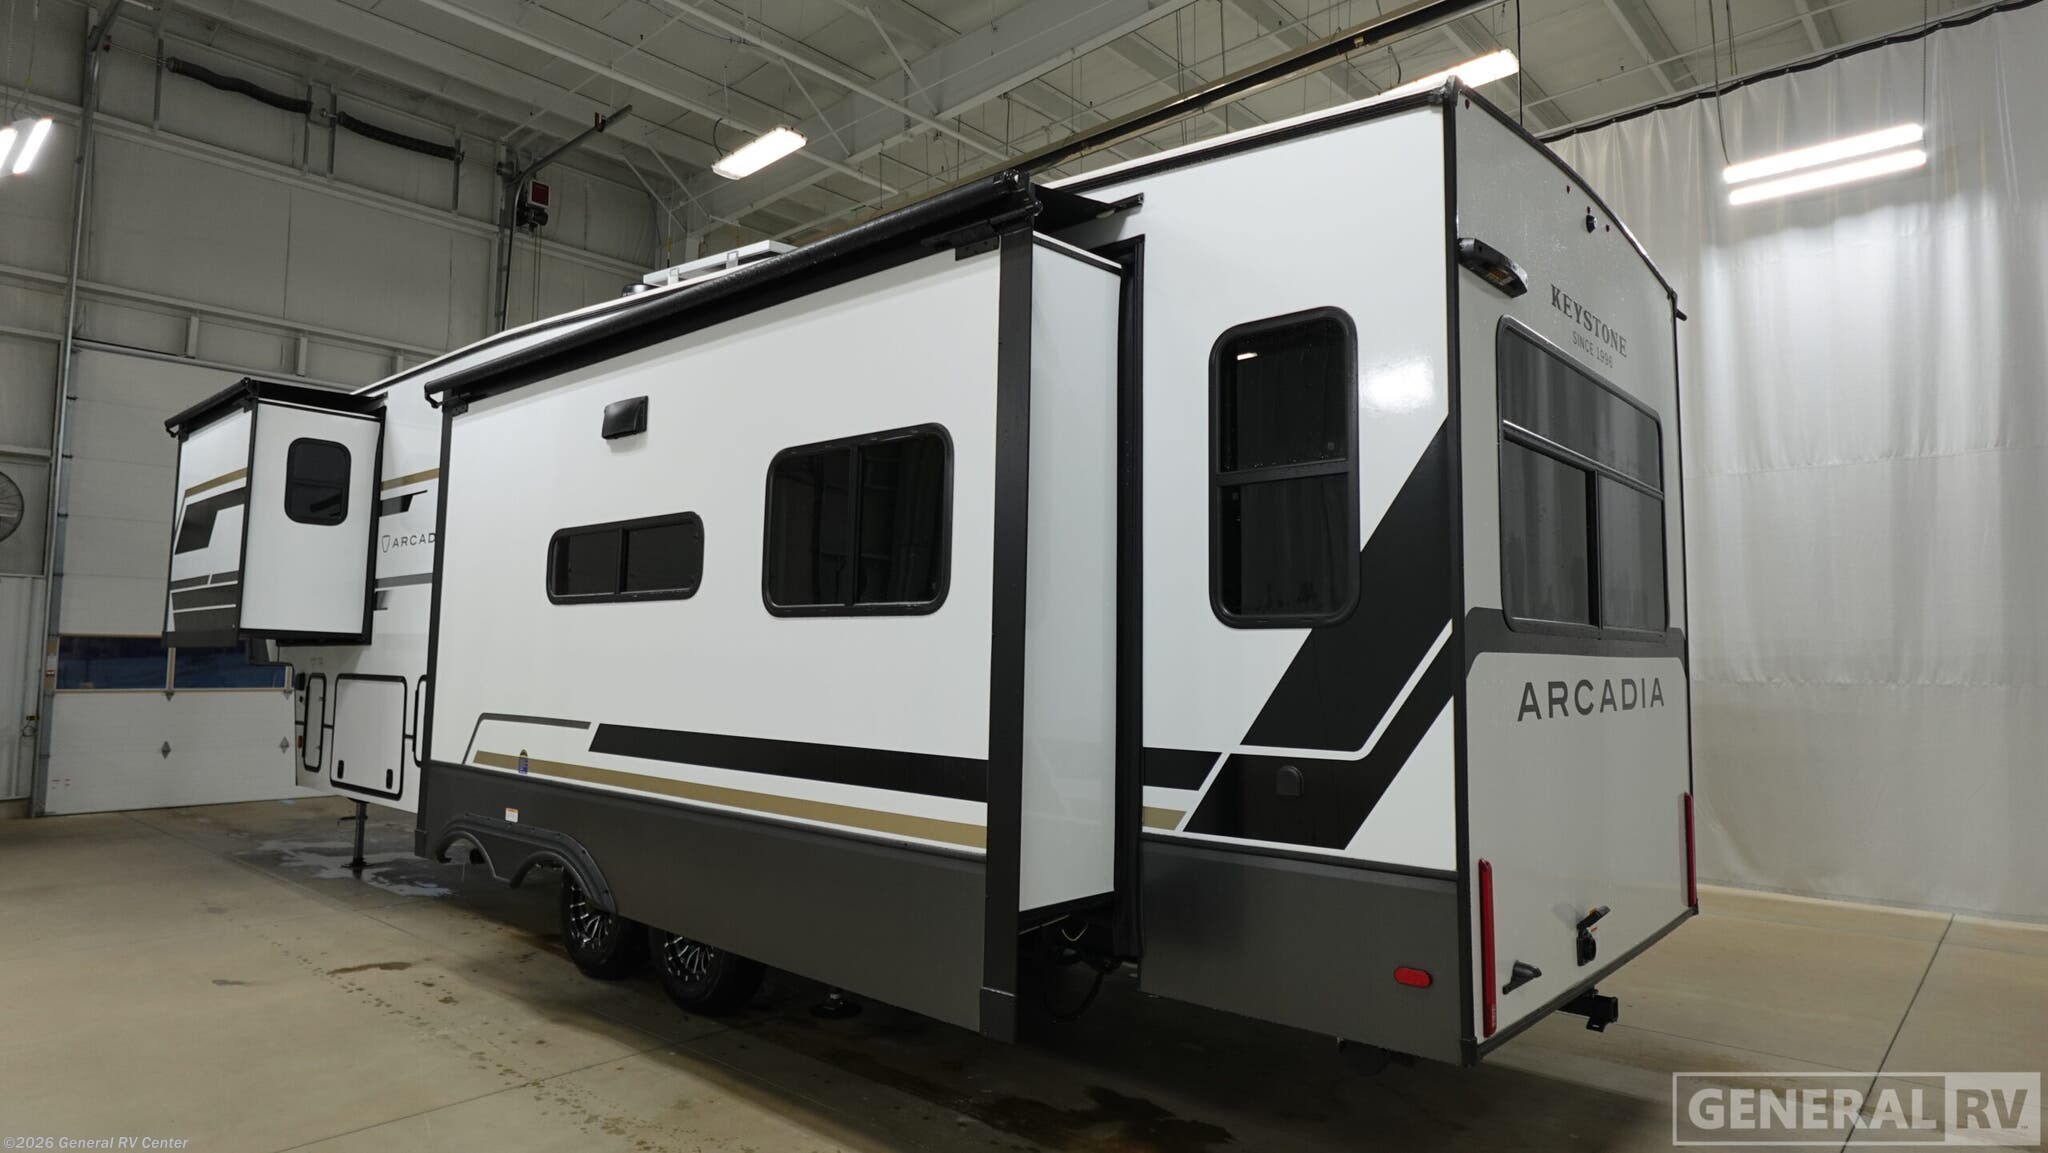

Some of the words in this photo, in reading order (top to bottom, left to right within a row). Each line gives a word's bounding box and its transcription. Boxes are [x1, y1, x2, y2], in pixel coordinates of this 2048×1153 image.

[1551, 283, 1627, 358] KEYSTONE
[1572, 330, 1595, 357] SINCE
[1517, 677, 1665, 722] ARCADIA
